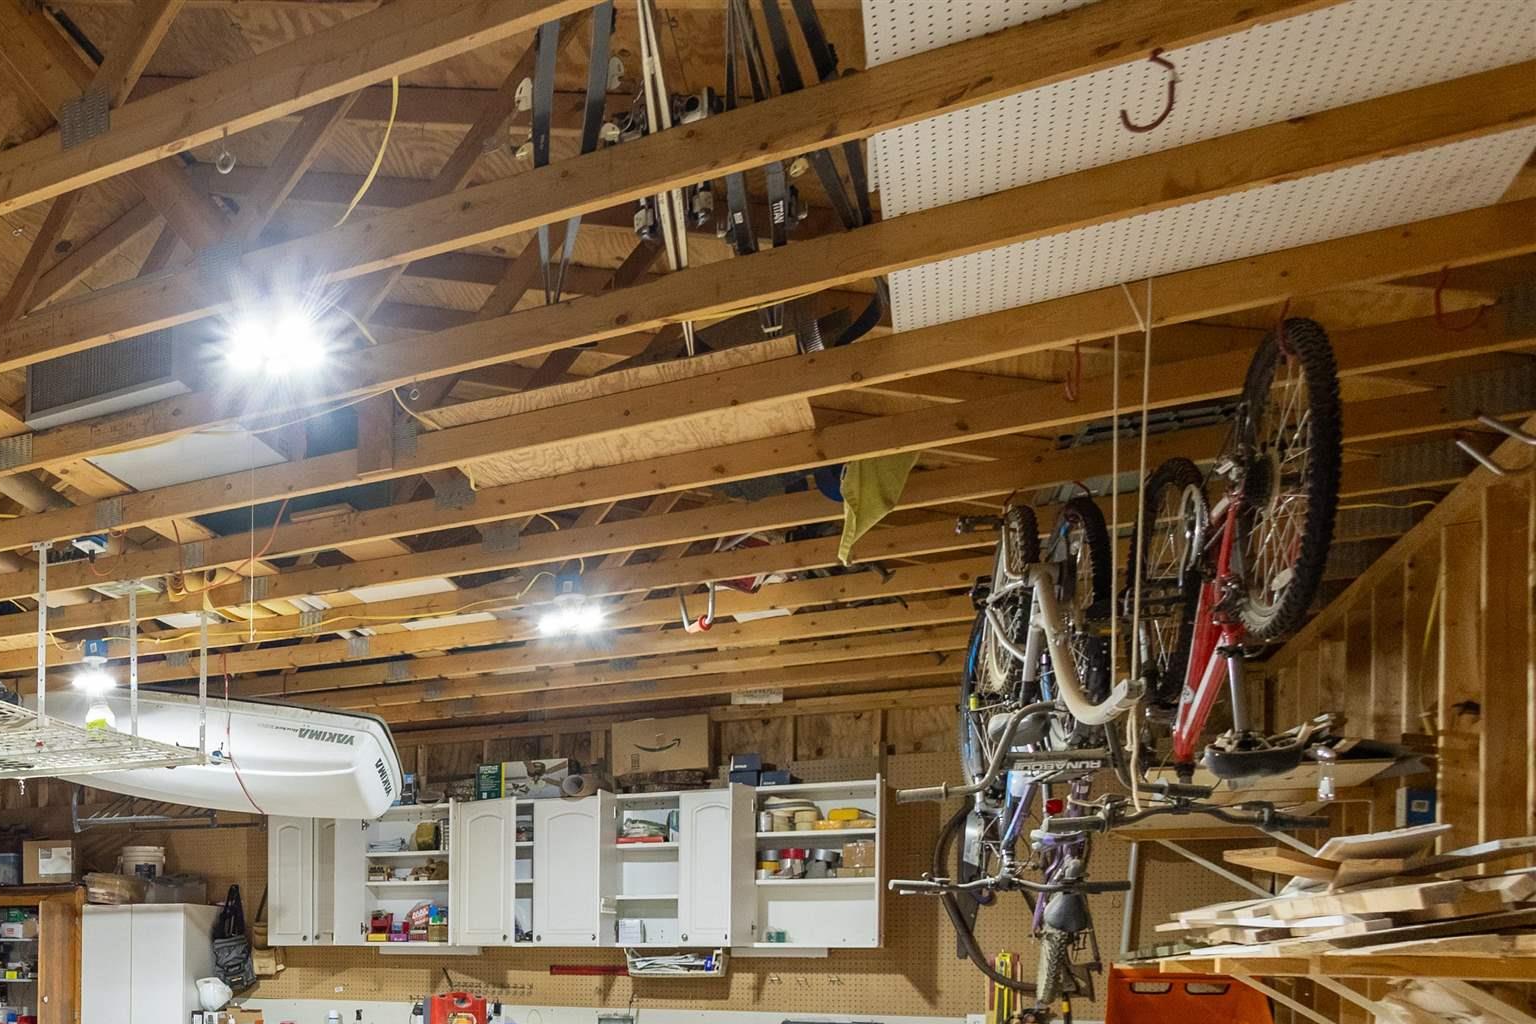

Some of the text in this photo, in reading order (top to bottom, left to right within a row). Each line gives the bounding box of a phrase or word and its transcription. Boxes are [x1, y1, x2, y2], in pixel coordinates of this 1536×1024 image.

[773, 200, 784, 224] TITAN
[298, 727, 355, 746] YAKIMA
[375, 757, 392, 796] YAKIMA
